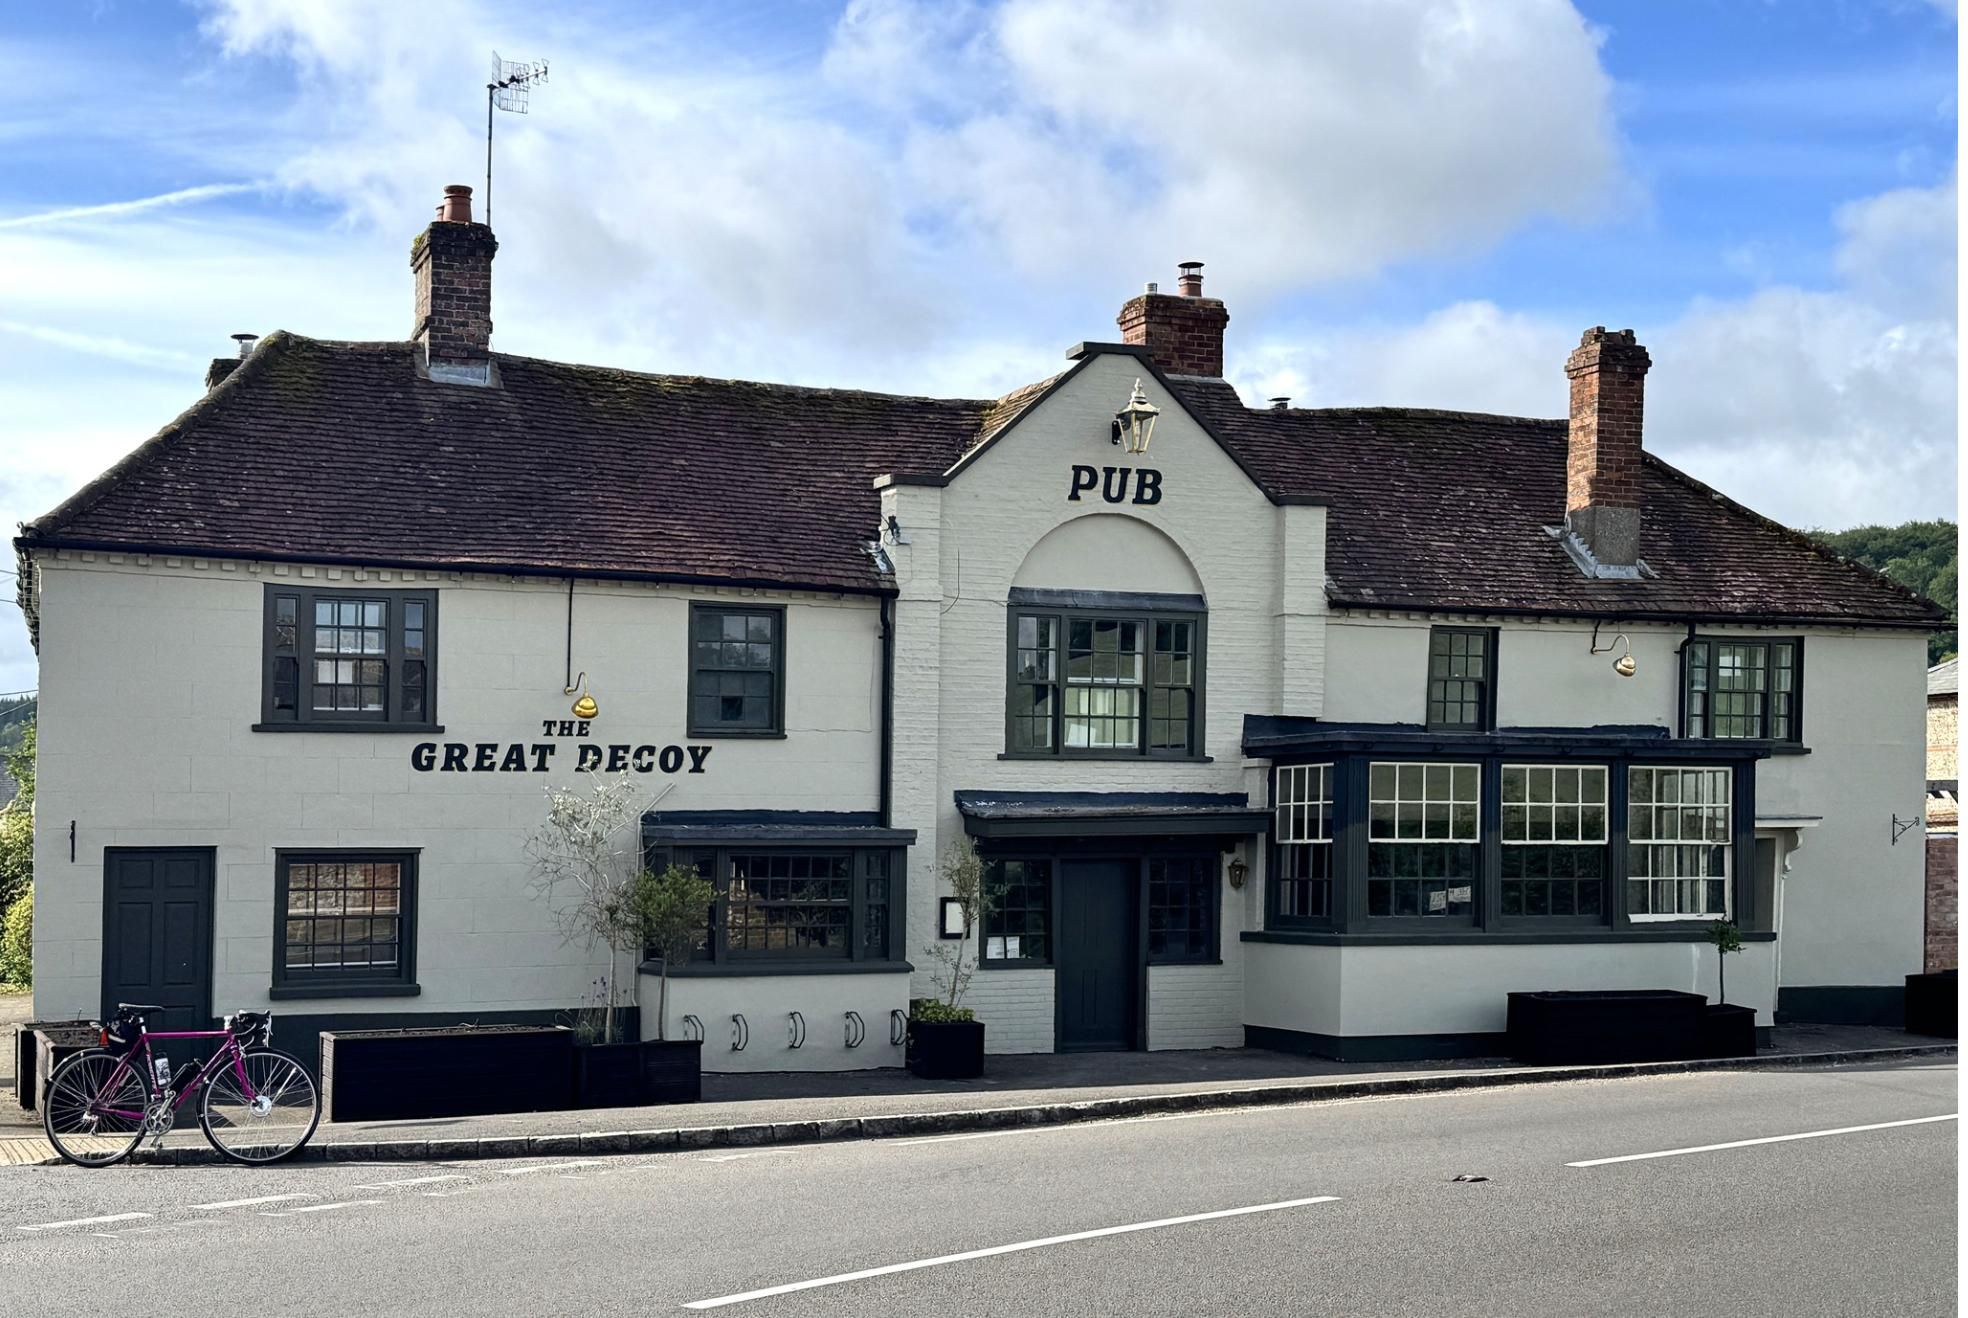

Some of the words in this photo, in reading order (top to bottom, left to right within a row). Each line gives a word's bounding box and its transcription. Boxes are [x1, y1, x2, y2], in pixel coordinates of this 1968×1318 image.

[1068, 465, 1163, 505] PUB
[543, 720, 591, 737] THE
[411, 742, 555, 773] GREAT
[575, 744, 713, 774] DECOY
